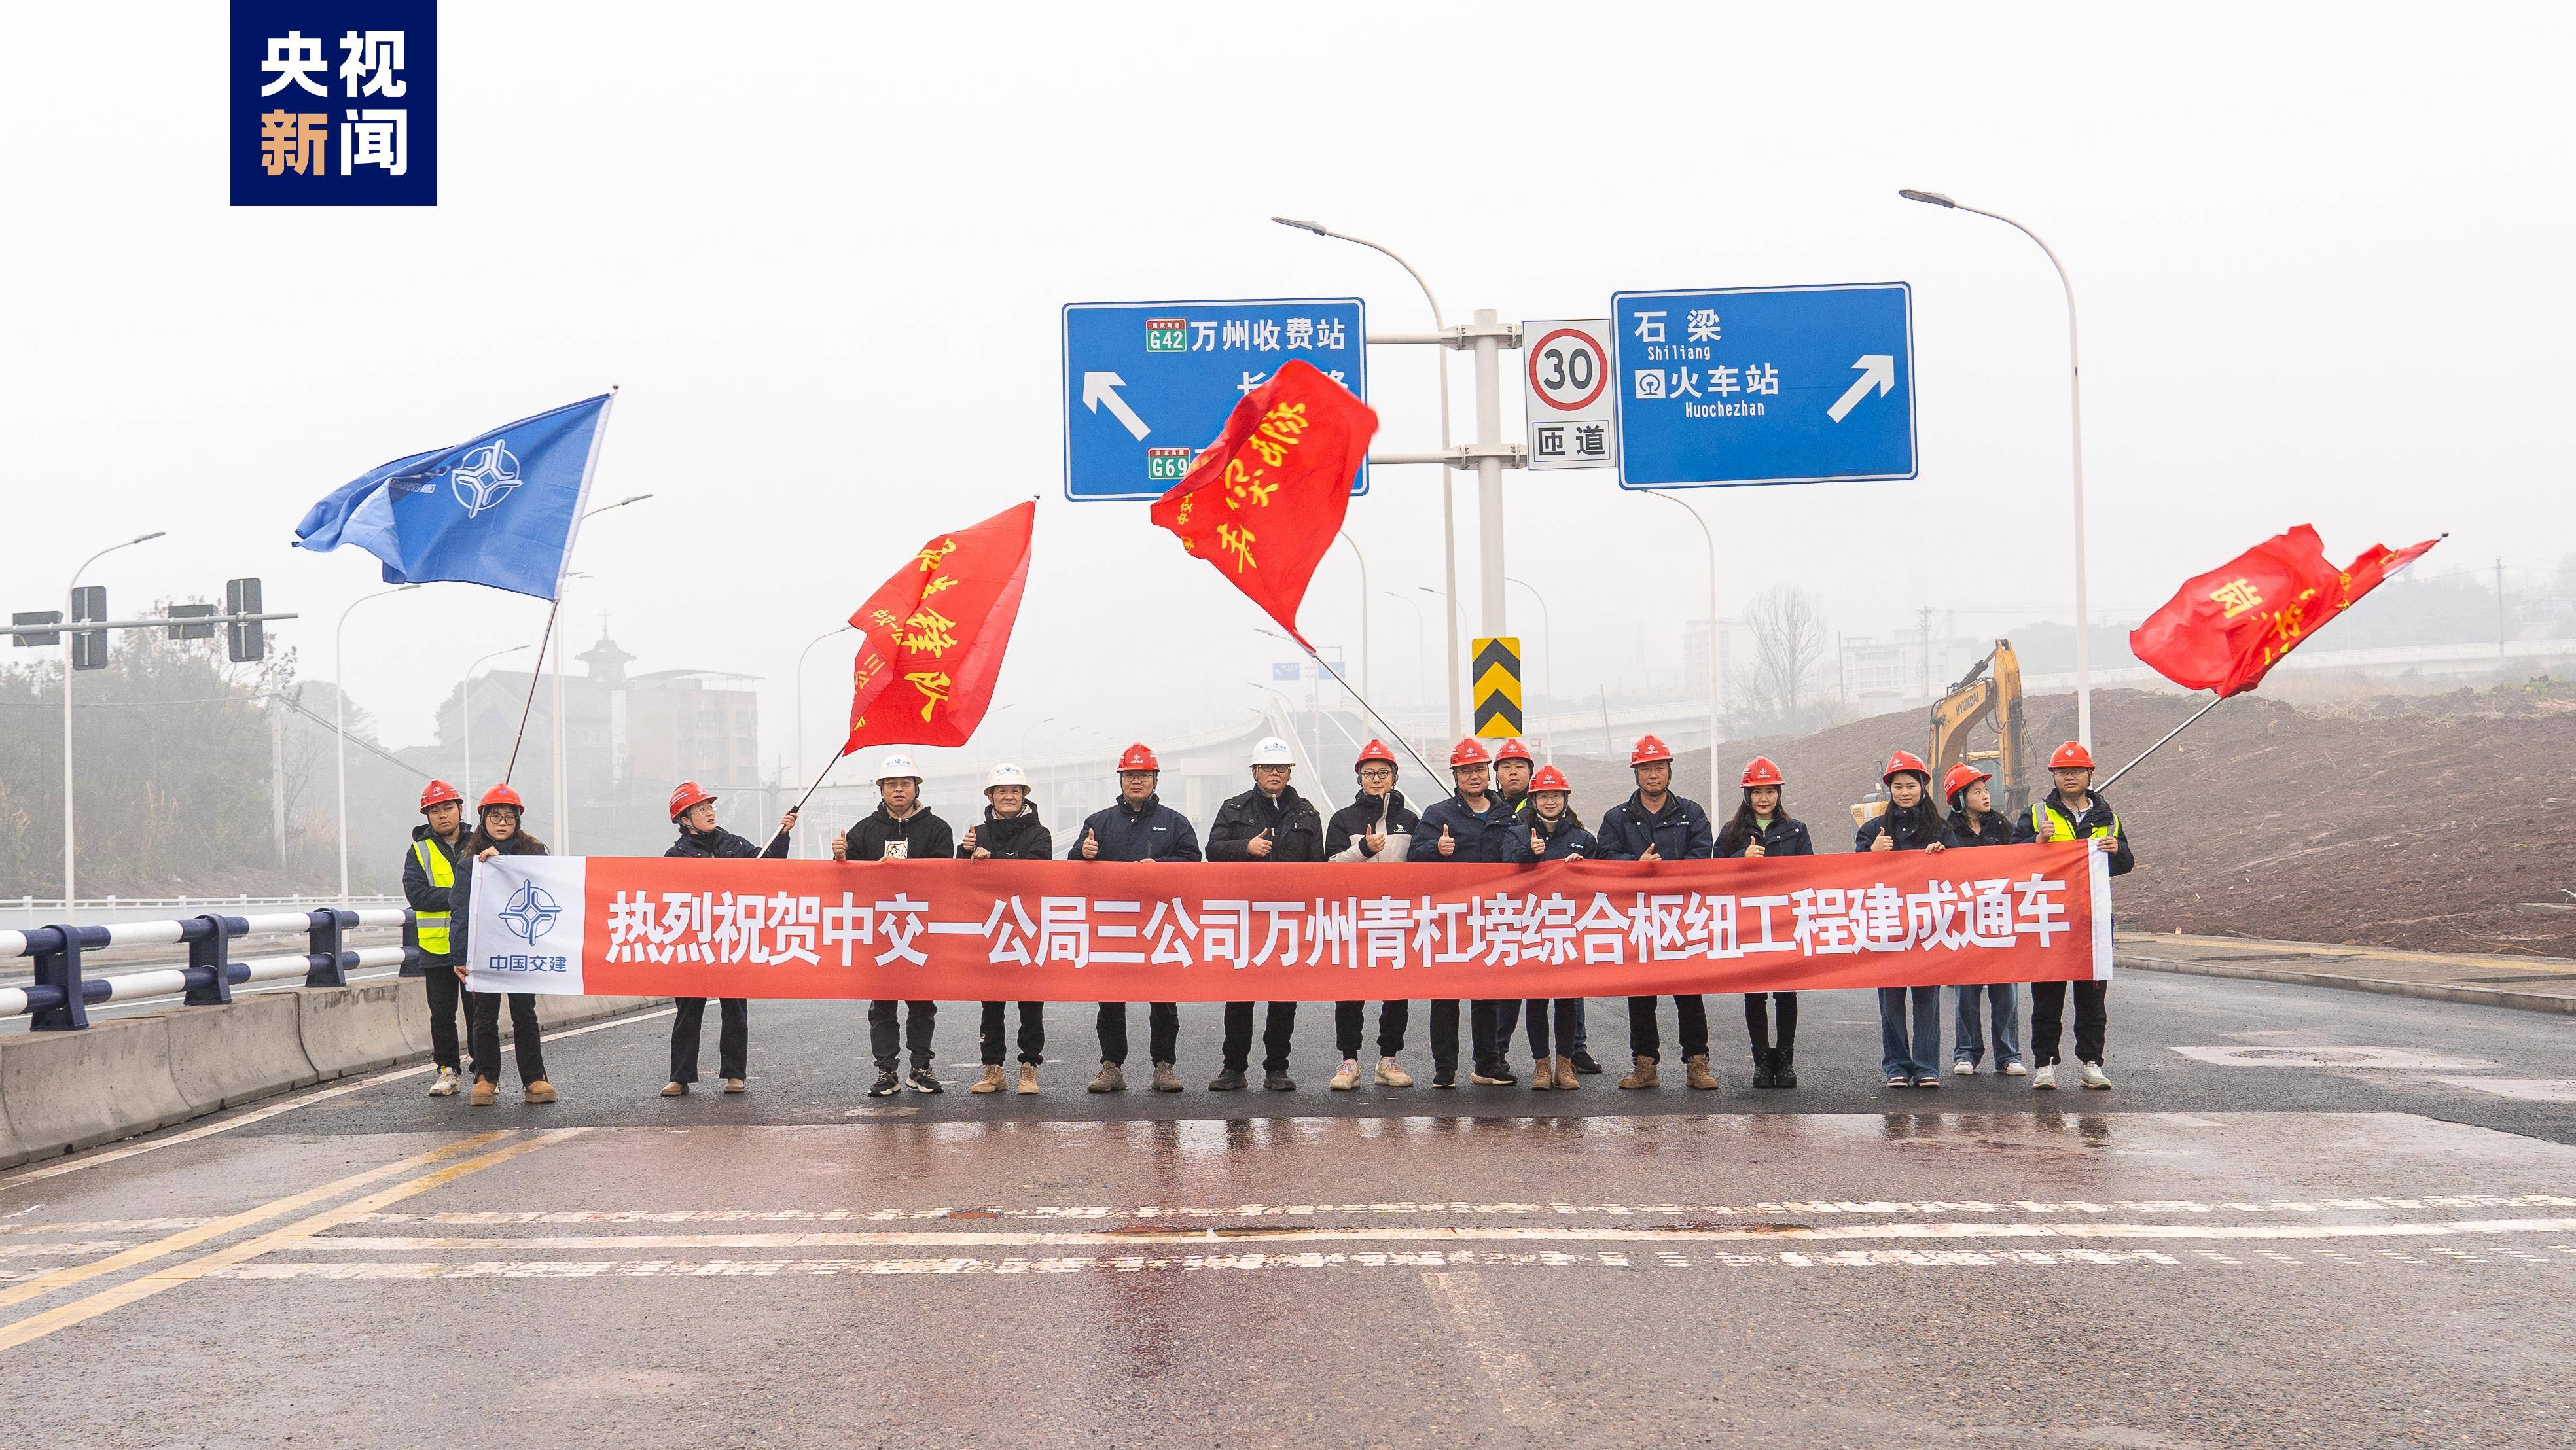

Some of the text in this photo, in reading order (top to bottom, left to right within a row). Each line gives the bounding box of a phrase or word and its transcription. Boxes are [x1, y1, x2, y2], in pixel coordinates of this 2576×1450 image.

[1150, 330, 1183, 349] G42
[1190, 317, 1346, 352] 万州收费站
[1634, 309, 1722, 344] 石梁
[1647, 345, 1711, 361] Shiliang
[1543, 347, 1593, 391] 30
[1669, 362, 1780, 400] 火车站
[1685, 400, 1765, 419] Huochezhan
[1537, 425, 1607, 457] 匝道
[1153, 457, 1187, 476] G69
[1955, 690, 1980, 717] HYUNDAI
[604, 872, 2071, 969] 热烈祝贺中交一公局三公司万州青杠塝综合枢纽工程建成通车
[489, 954, 568, 973] 中国交建
